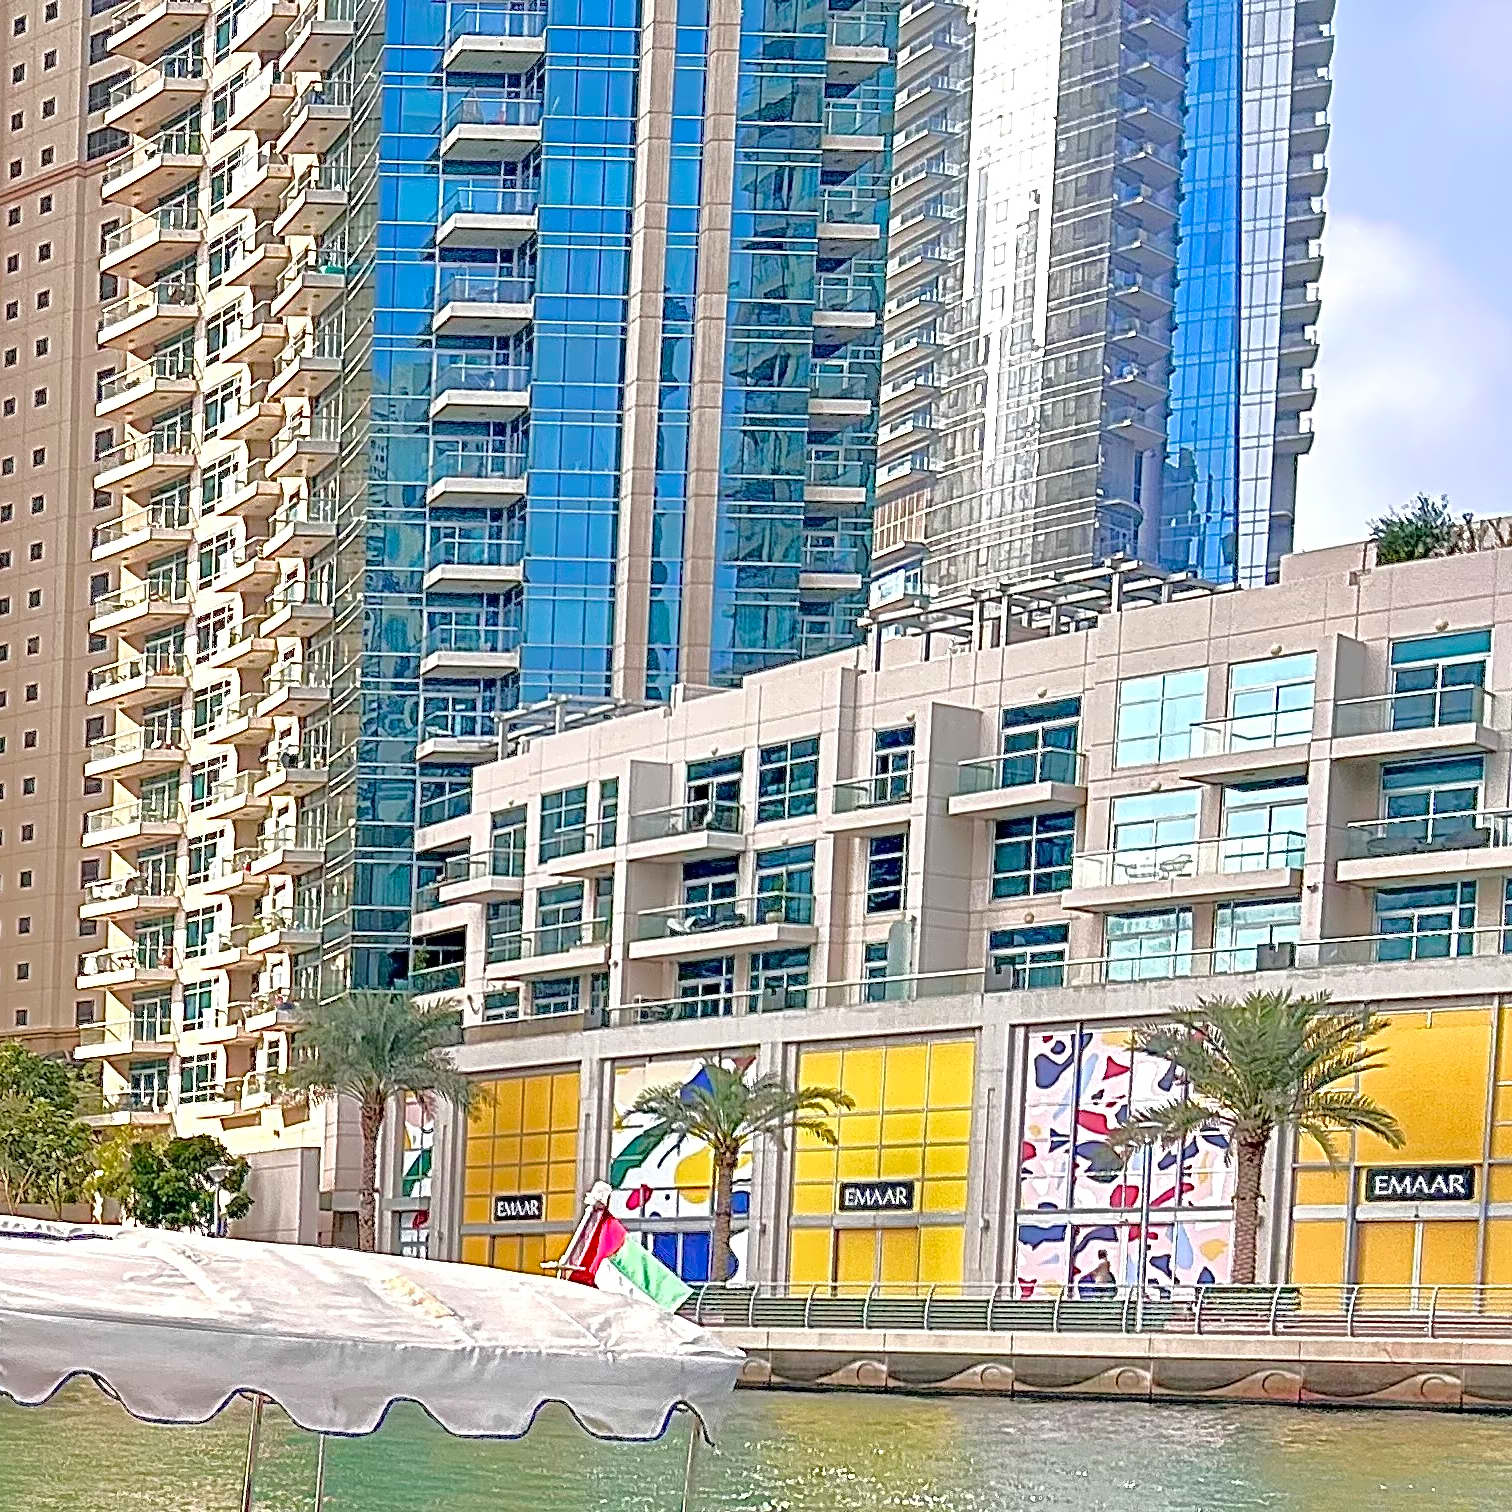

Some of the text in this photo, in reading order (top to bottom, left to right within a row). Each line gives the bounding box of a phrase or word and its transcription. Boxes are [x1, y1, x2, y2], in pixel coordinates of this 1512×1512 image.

[1374, 1174, 1466, 1195] EMAAR
[844, 1186, 907, 1206] EMAAR
[497, 1199, 539, 1217] EMAAR
